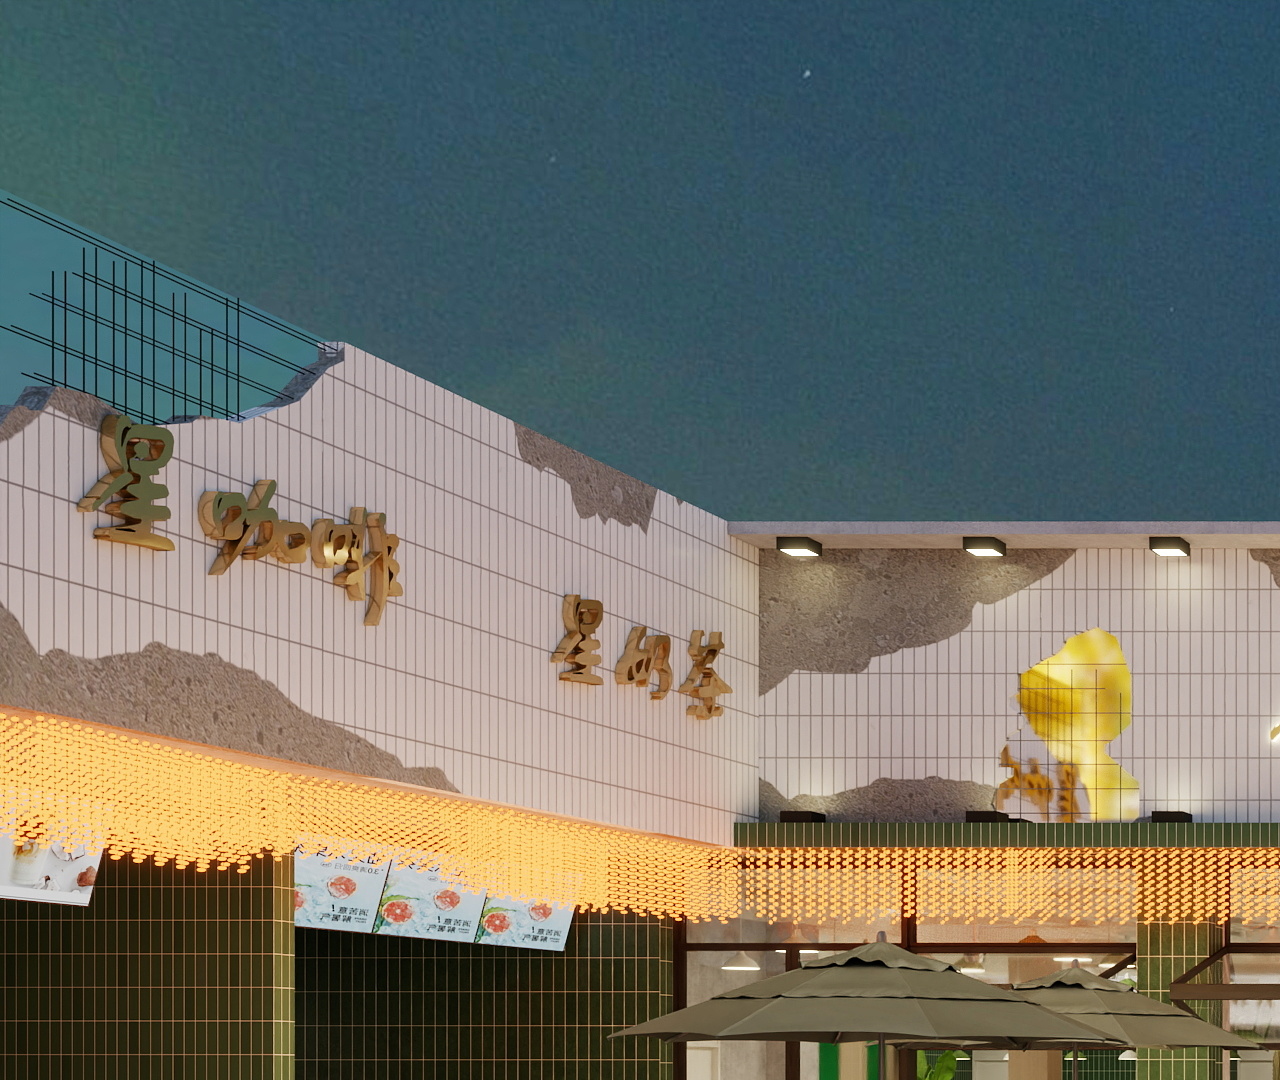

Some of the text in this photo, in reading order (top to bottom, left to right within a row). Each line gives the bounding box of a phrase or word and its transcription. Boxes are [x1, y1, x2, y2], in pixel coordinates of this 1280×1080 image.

[77, 414, 403, 626] 星咖啡
[550, 594, 733, 720] 星奶茶
